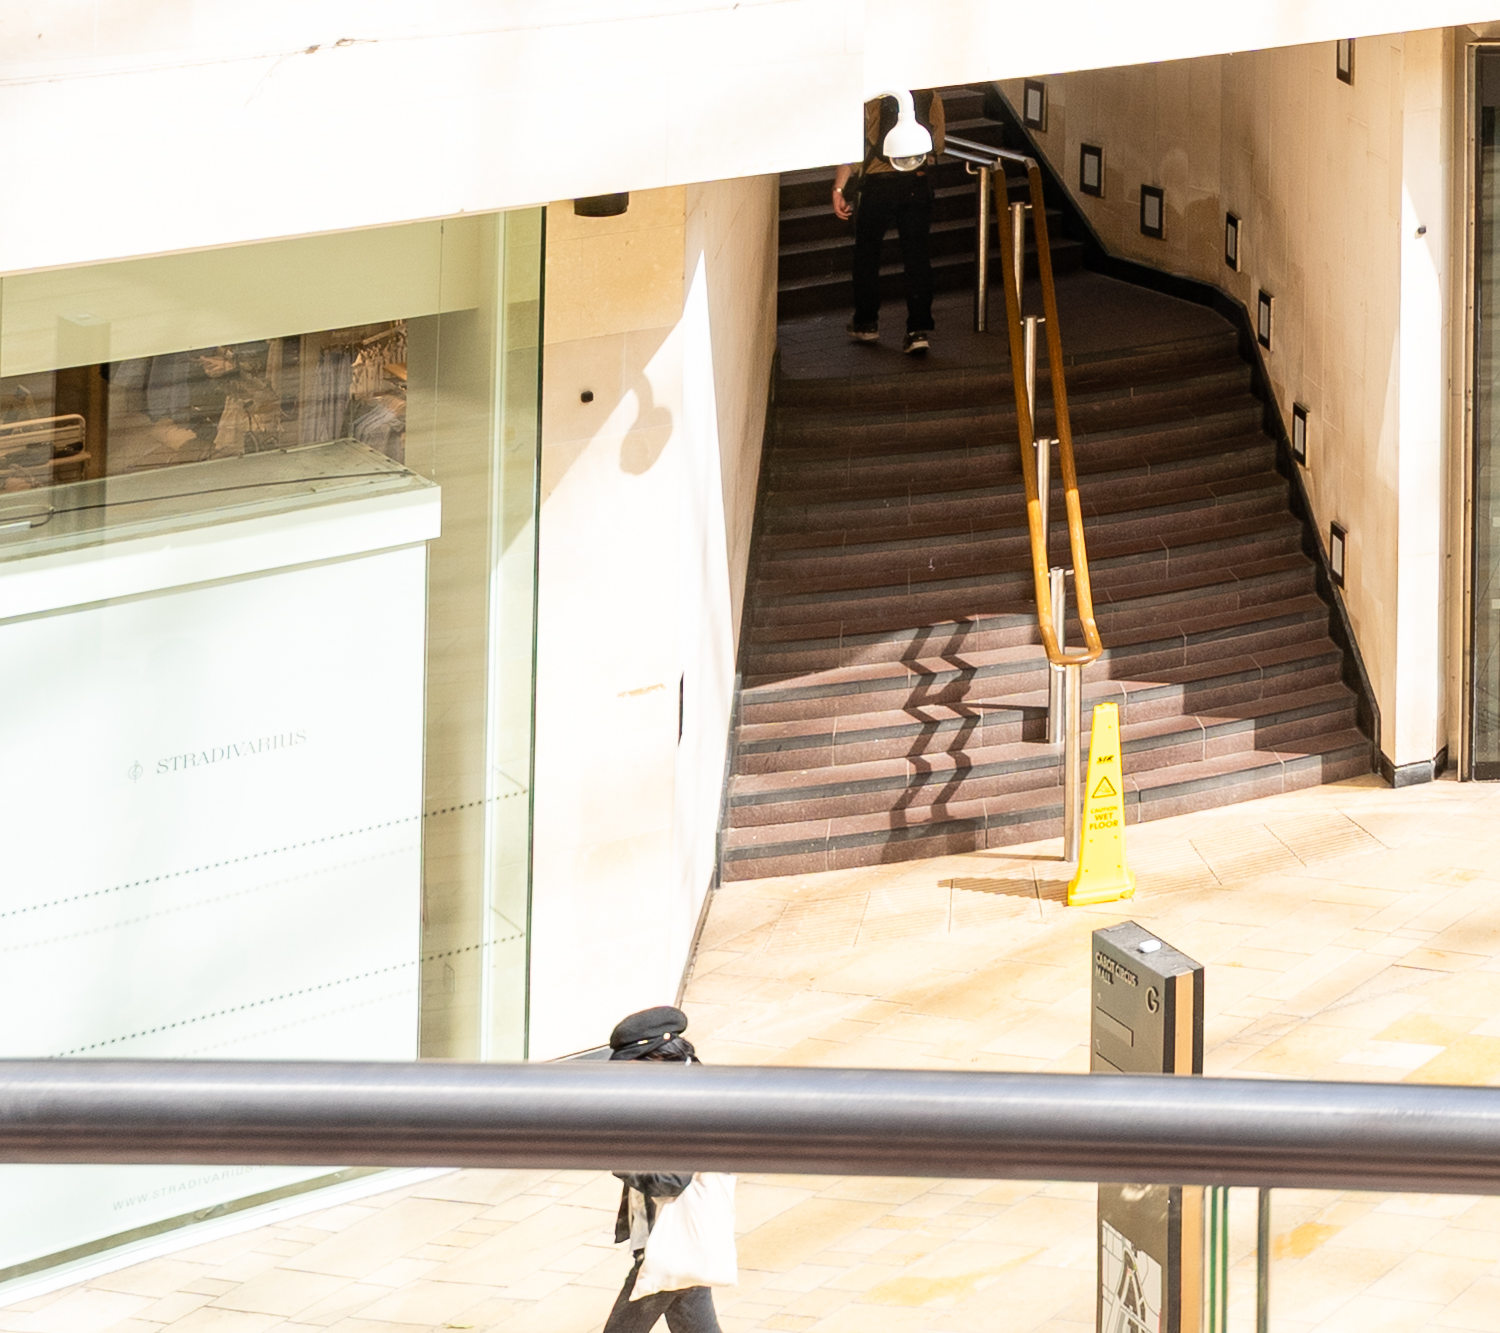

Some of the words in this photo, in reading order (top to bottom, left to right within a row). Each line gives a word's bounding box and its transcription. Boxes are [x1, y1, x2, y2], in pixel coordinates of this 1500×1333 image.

[156, 729, 307, 774] STRADIVARIUS
[1089, 820, 1118, 830] FLOOR
[1095, 812, 1113, 821] WET
[1145, 986, 1159, 1014] G
